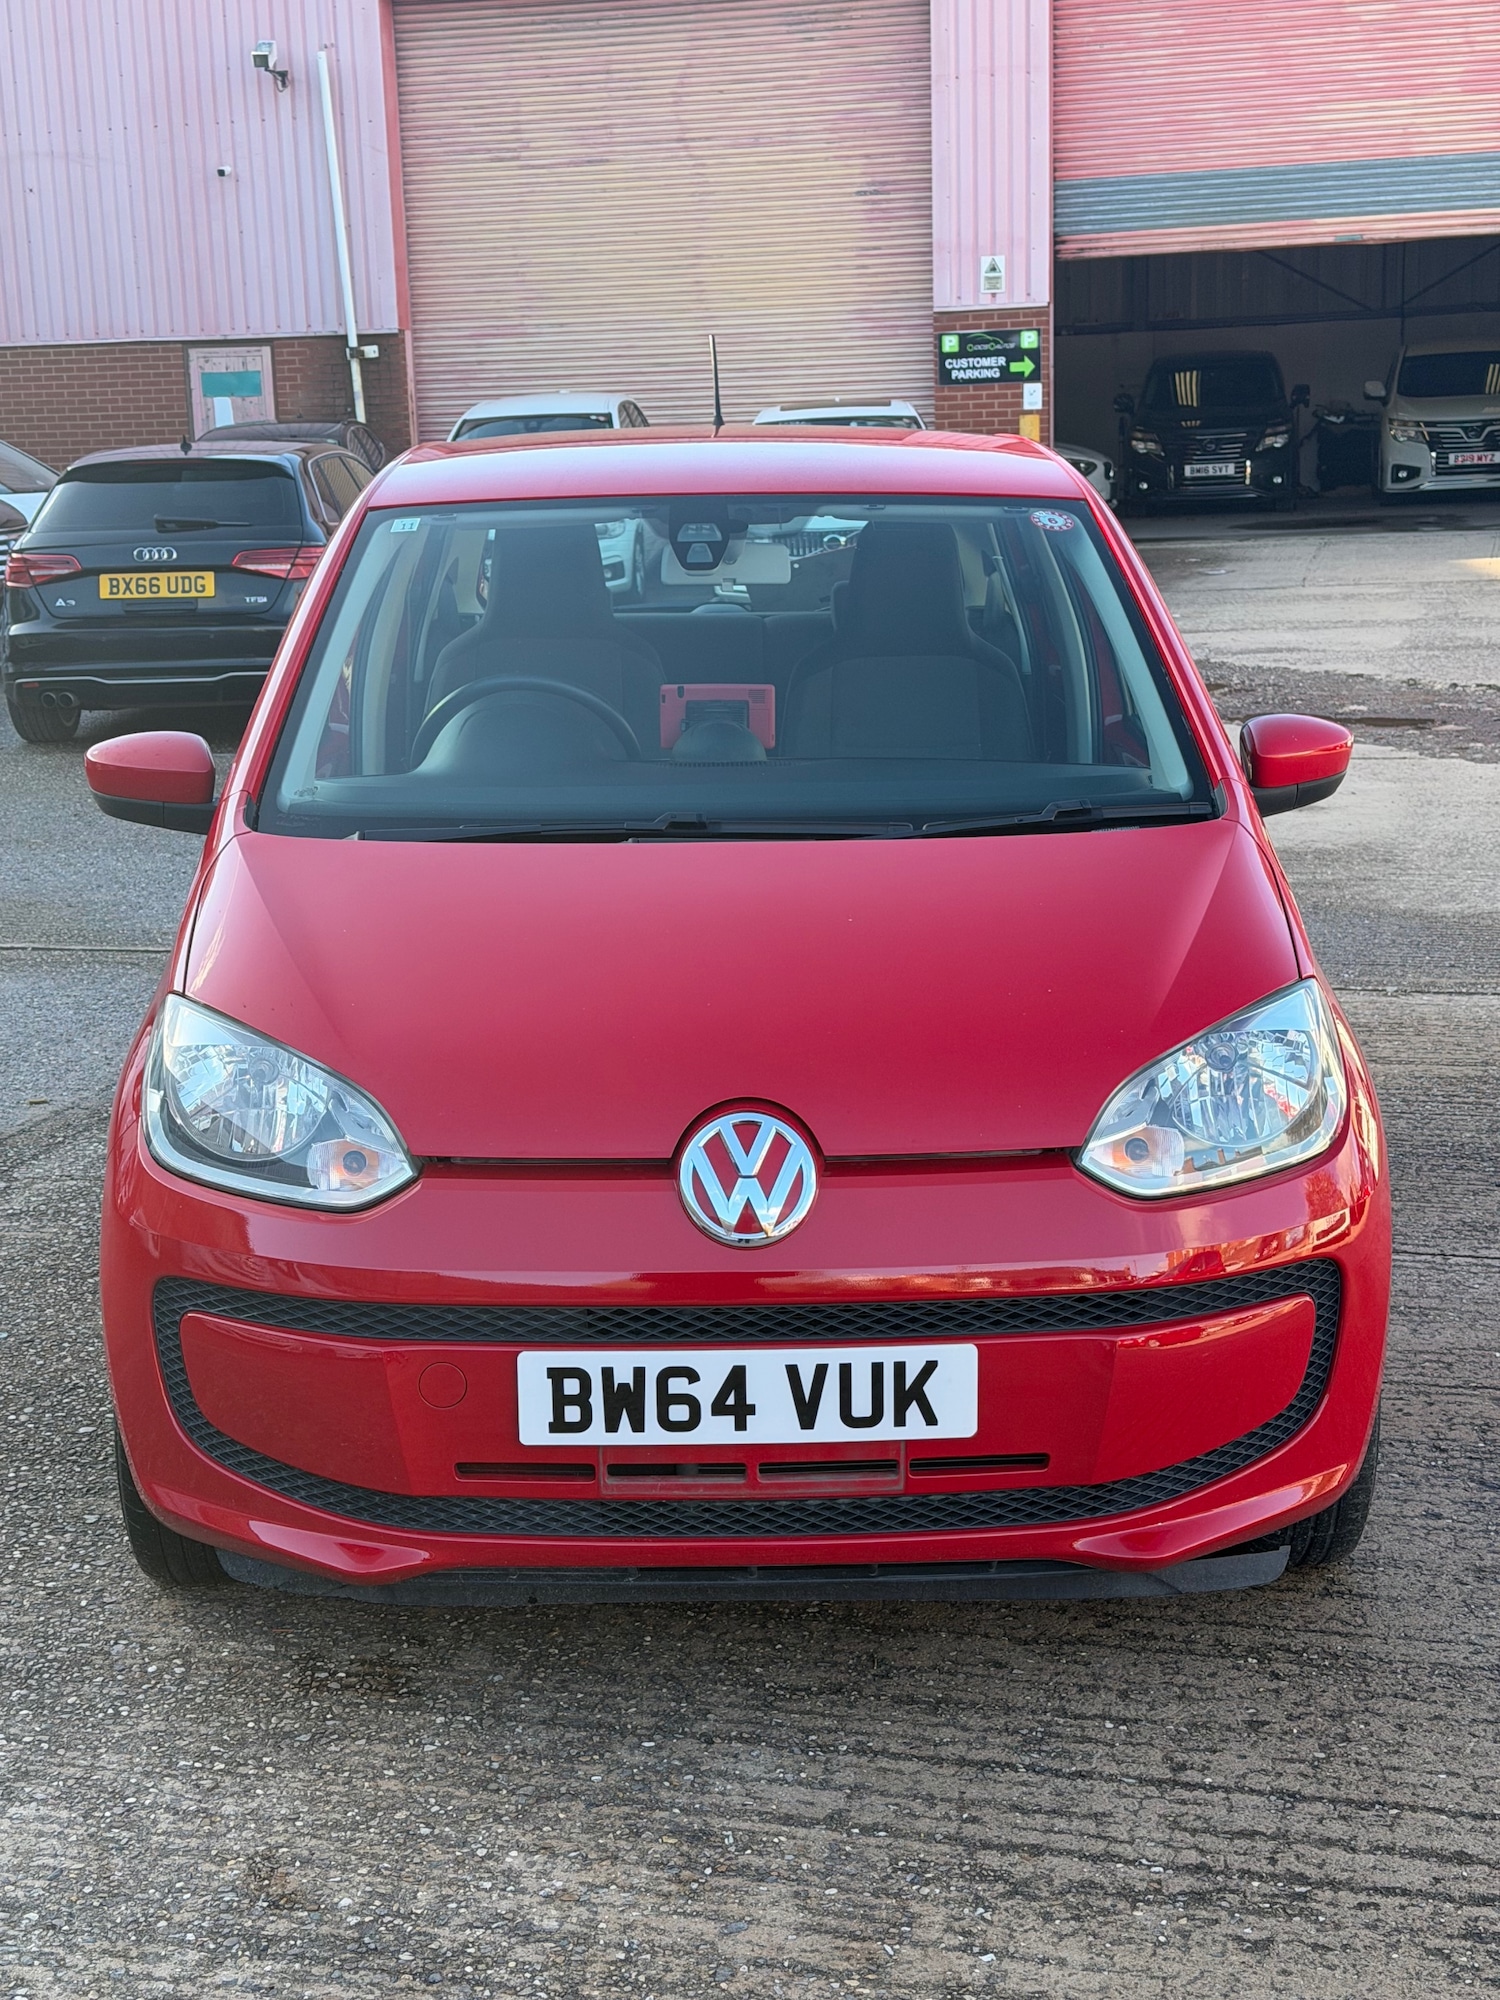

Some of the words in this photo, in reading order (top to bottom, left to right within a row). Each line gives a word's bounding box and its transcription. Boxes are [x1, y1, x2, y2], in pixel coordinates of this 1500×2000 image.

[945, 336, 956, 351] P
[1024, 331, 1035, 348] P
[945, 356, 1007, 369] CUSTOMER
[951, 367, 1000, 380] PARKING
[1212, 464, 1230, 474] SVT
[108, 577, 160, 596] BX66
[167, 575, 206, 594] UDG
[55, 597, 76, 607] A3
[244, 596, 268, 604] TFSI
[546, 1364, 756, 1434] BW64
[785, 1360, 939, 1430] VUK
